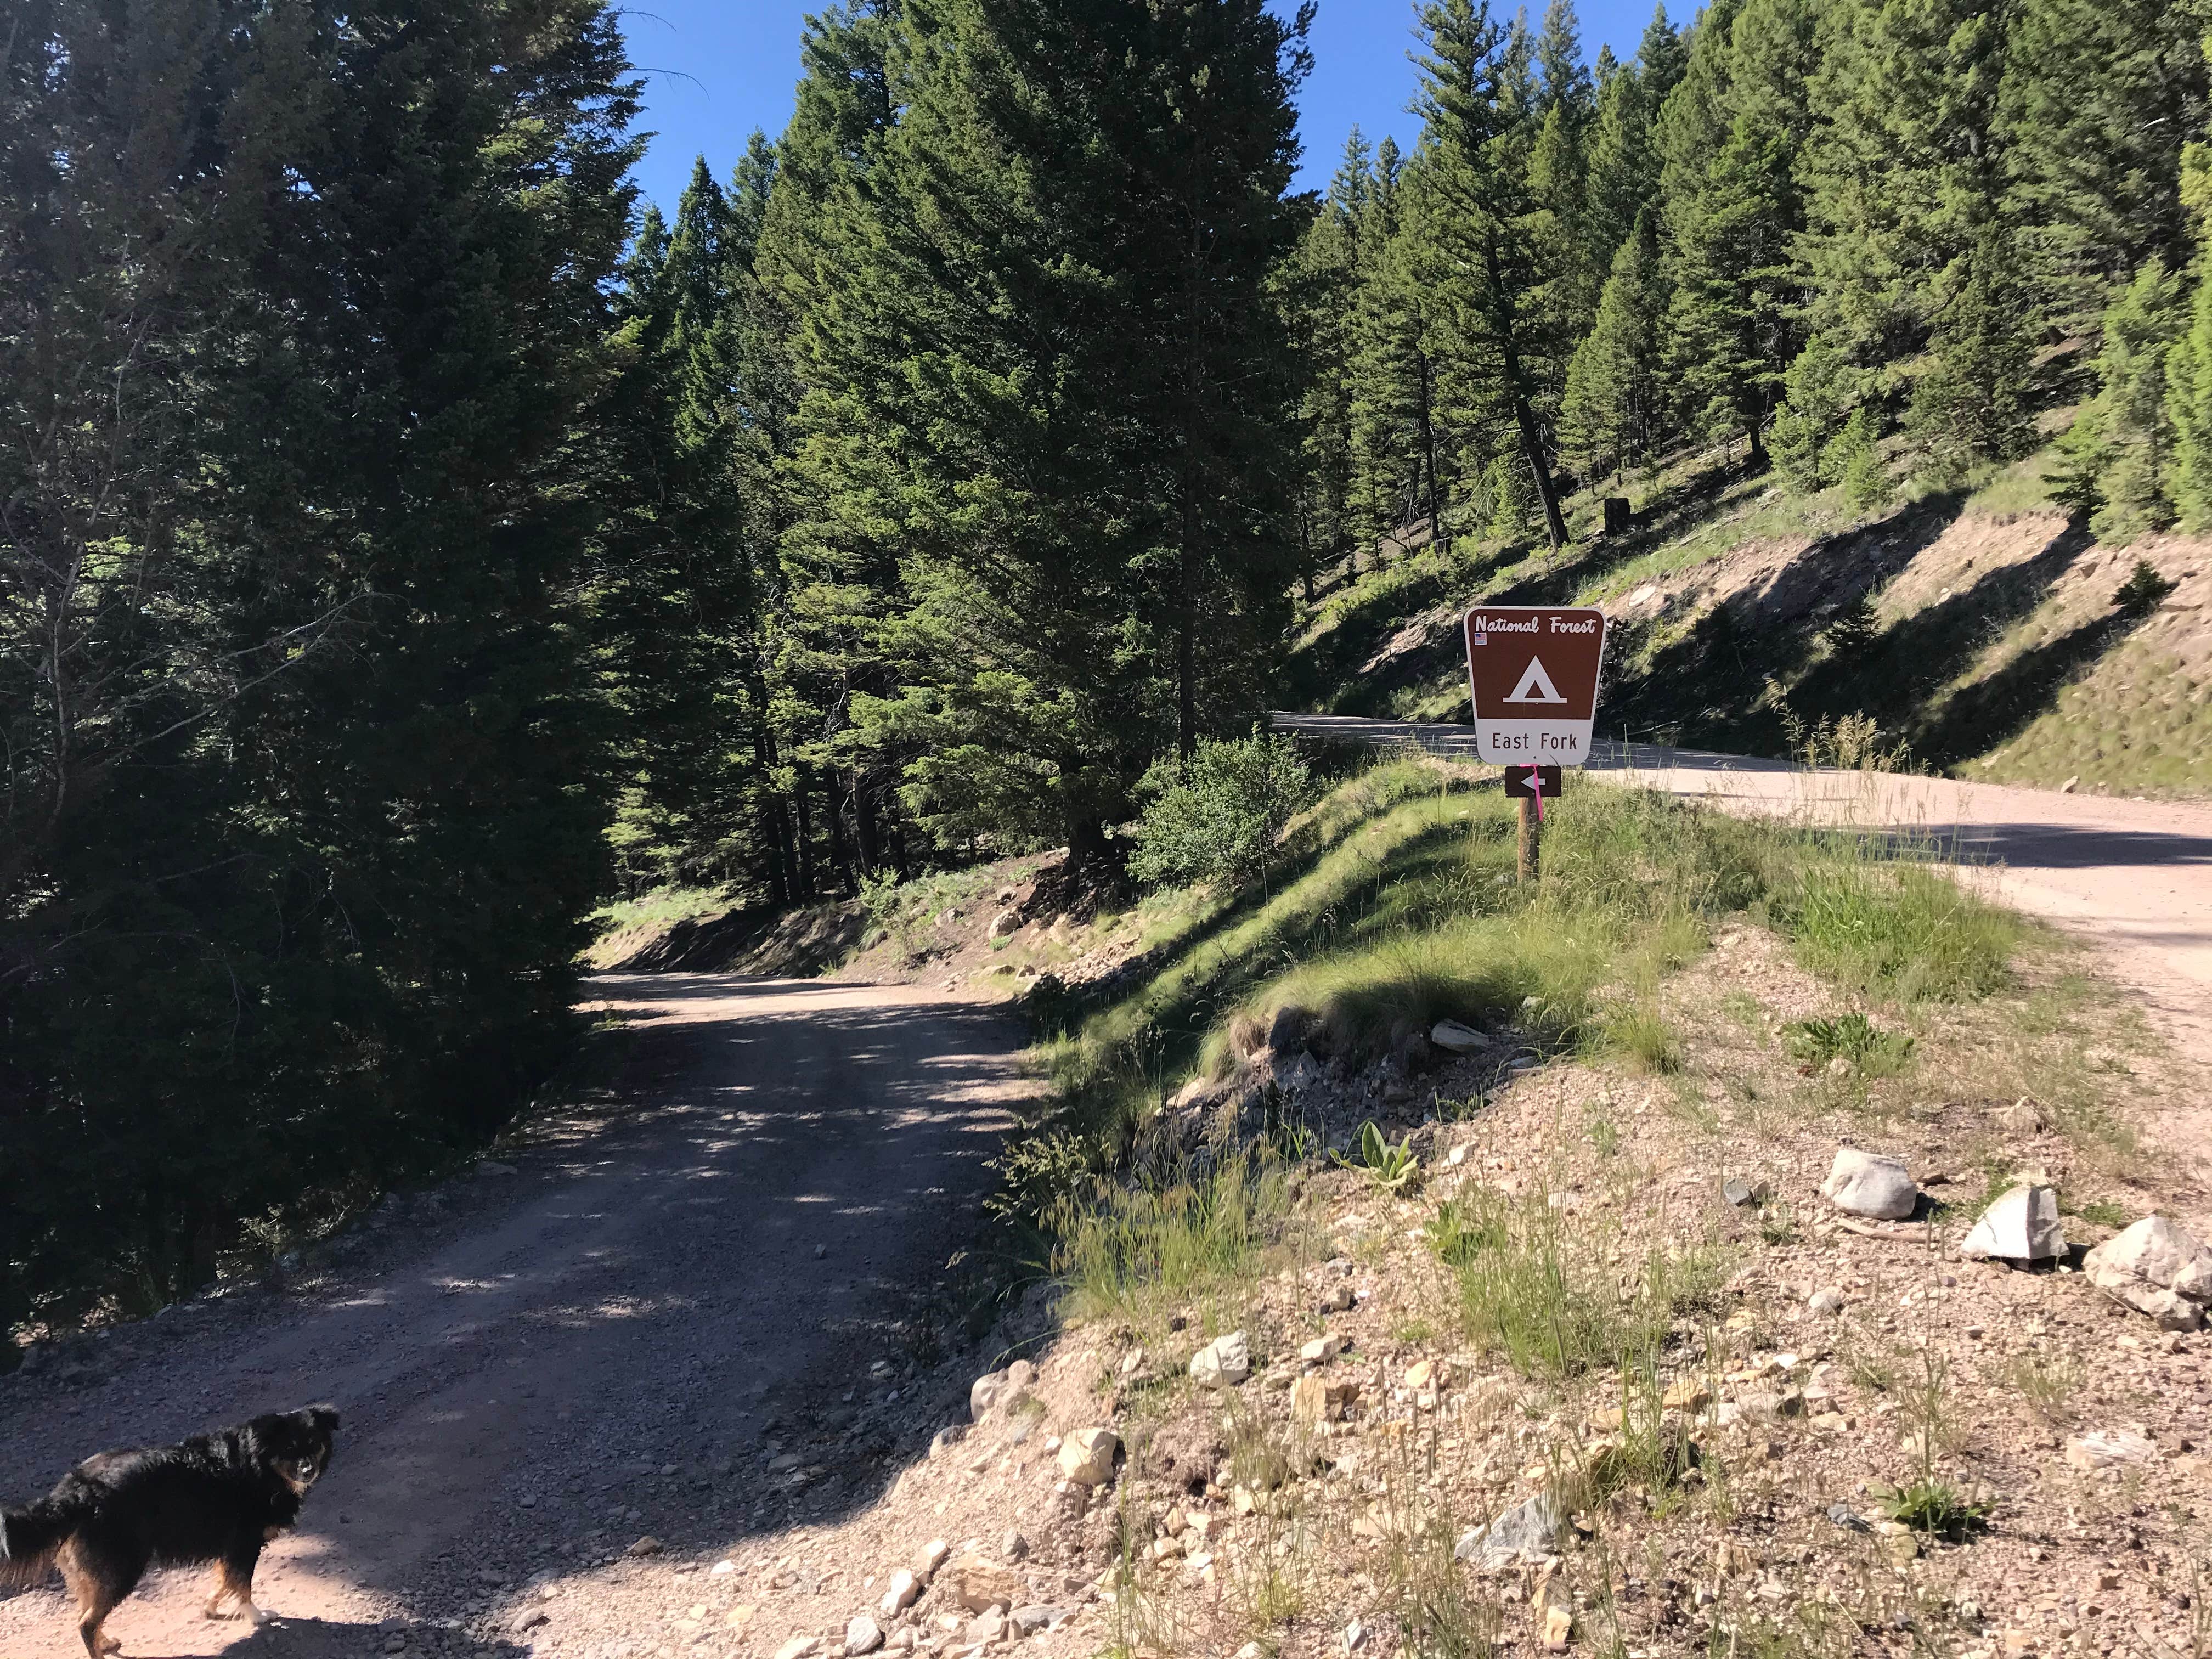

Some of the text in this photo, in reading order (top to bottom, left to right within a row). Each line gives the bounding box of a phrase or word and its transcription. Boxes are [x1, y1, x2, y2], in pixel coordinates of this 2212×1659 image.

[1475, 615, 1596, 634] National Forest
[1492, 732, 1577, 749] East Fork
